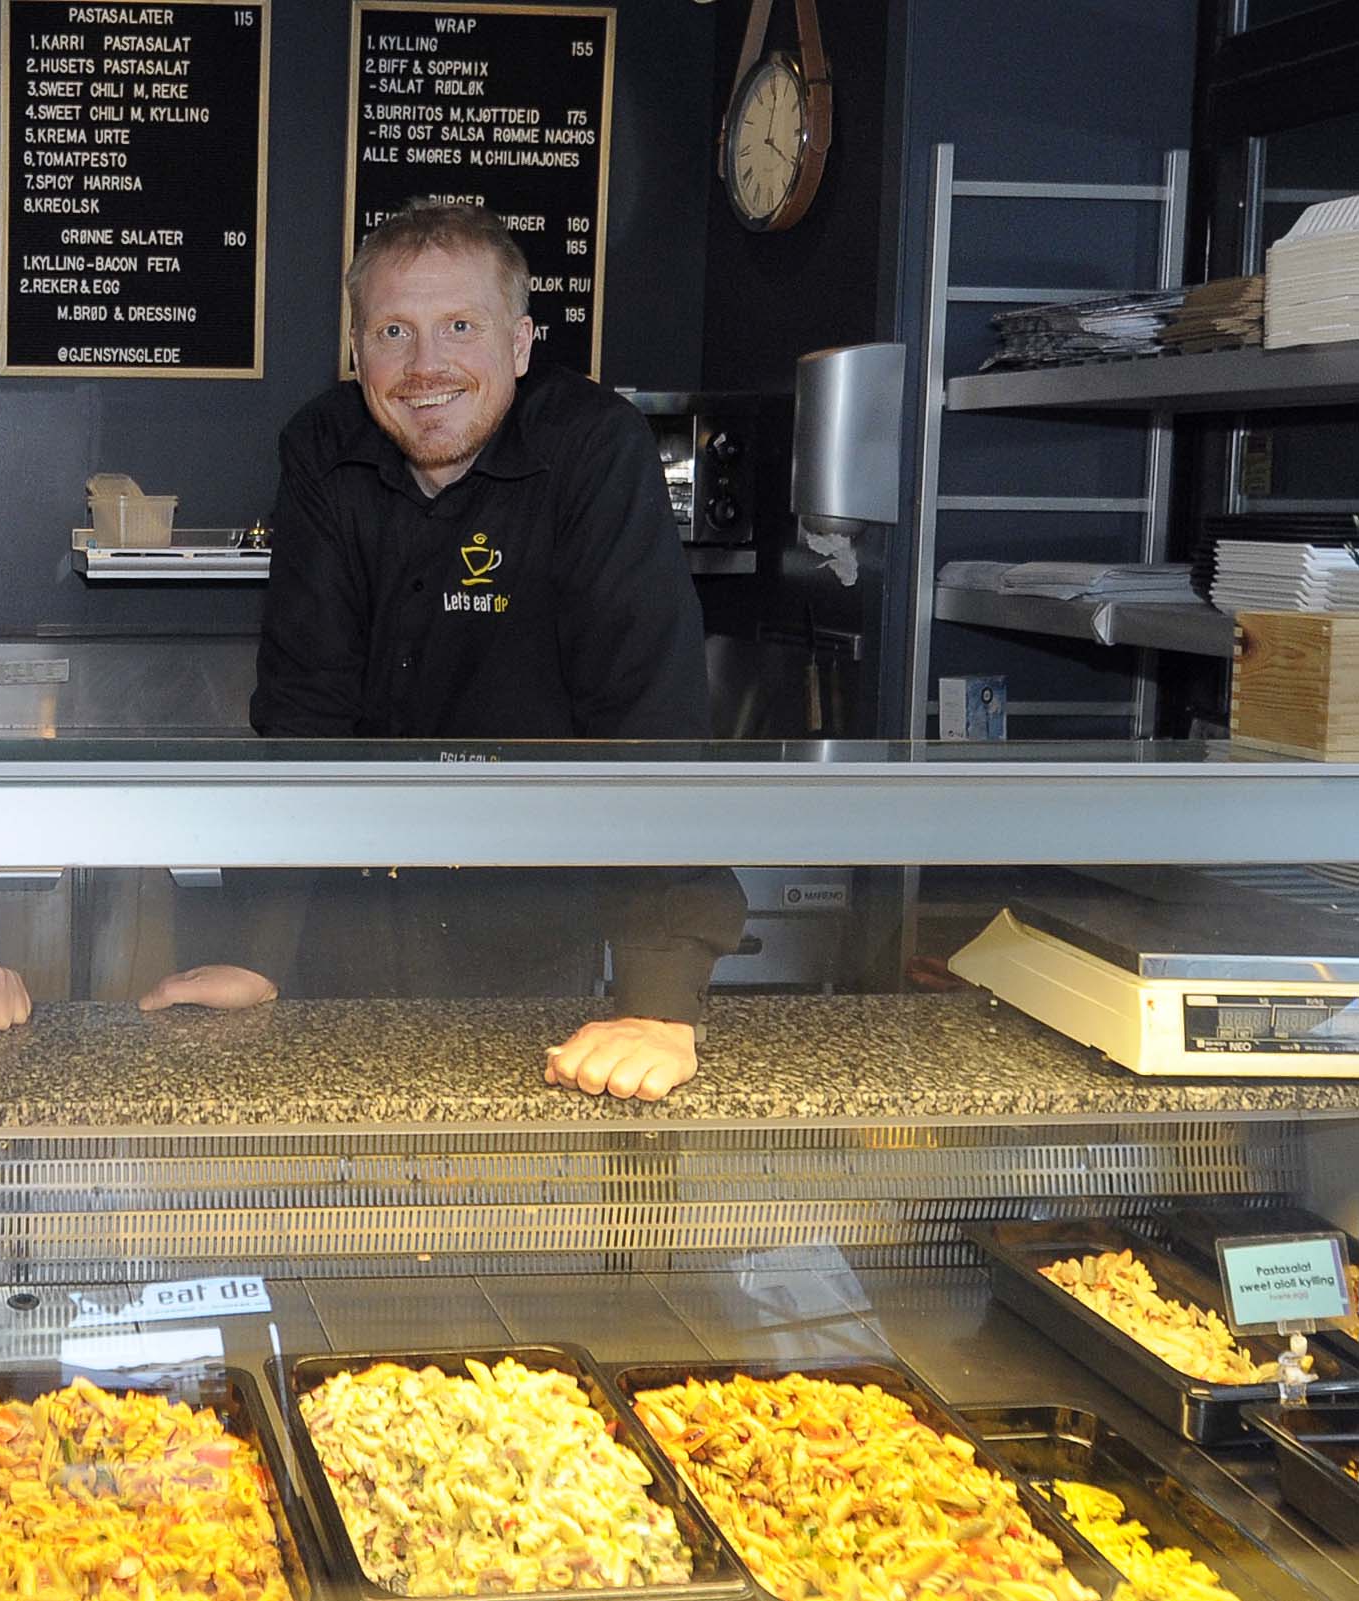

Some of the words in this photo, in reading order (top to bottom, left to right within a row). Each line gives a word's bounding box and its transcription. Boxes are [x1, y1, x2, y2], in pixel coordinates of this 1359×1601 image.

[68, 7, 174, 25] PASTASALATER
[234, 11, 254, 26] 115
[434, 18, 477, 33] WRAP
[30, 34, 85, 51] 1.KARRI
[103, 35, 192, 53] PASTASALAT
[379, 35, 438, 52] KYLLING
[572, 41, 594, 57] 155
[26, 57, 95, 74] 2.HUSETS
[103, 58, 191, 76] PASTASALAT
[412, 59, 423, 75] &
[427, 60, 489, 77] SOPPMIX
[27, 80, 84, 98] 3.SWEET
[89, 82, 124, 98] CHILI
[435, 79, 485, 96] RØDLØK
[25, 104, 82, 121] 4.SWEET
[89, 105, 124, 122] CHILI
[149, 106, 210, 123] KYLLING
[363, 104, 444, 122] 3.BURRITOS
[567, 110, 587, 126] 175
[24, 127, 88, 144] 5.KREMA
[94, 128, 130, 145] URTE
[407, 125, 434, 140] OST
[440, 125, 485, 142] SALSA
[493, 127, 540, 144] RØMME
[544, 128, 595, 145] NACHOS
[23, 151, 127, 168] 6.TOMATPESTO
[362, 146, 399, 163] ALLE
[406, 147, 462, 164] SMØRES
[24, 174, 75, 191] 7.SPICY
[83, 175, 143, 191] HARRISA
[23, 197, 100, 214] 8.KREOLSK
[567, 217, 590, 233] 160
[60, 228, 114, 245] GRØNNE
[120, 229, 184, 246] SALATER
[224, 231, 247, 247] 160
[566, 239, 587, 255] 165
[147, 256, 181, 273] FETA
[19, 277, 79, 294] 2.REKER
[79, 278, 92, 295] &
[92, 278, 121, 295] EGG
[113, 305, 125, 321] &
[128, 305, 197, 323] DRESSING
[565, 307, 586, 323] 195
[1255, 1261, 1312, 1278] Pastasalat
[1299, 1274, 1336, 1289] kylling
[157, 1283, 208, 1305] eat
